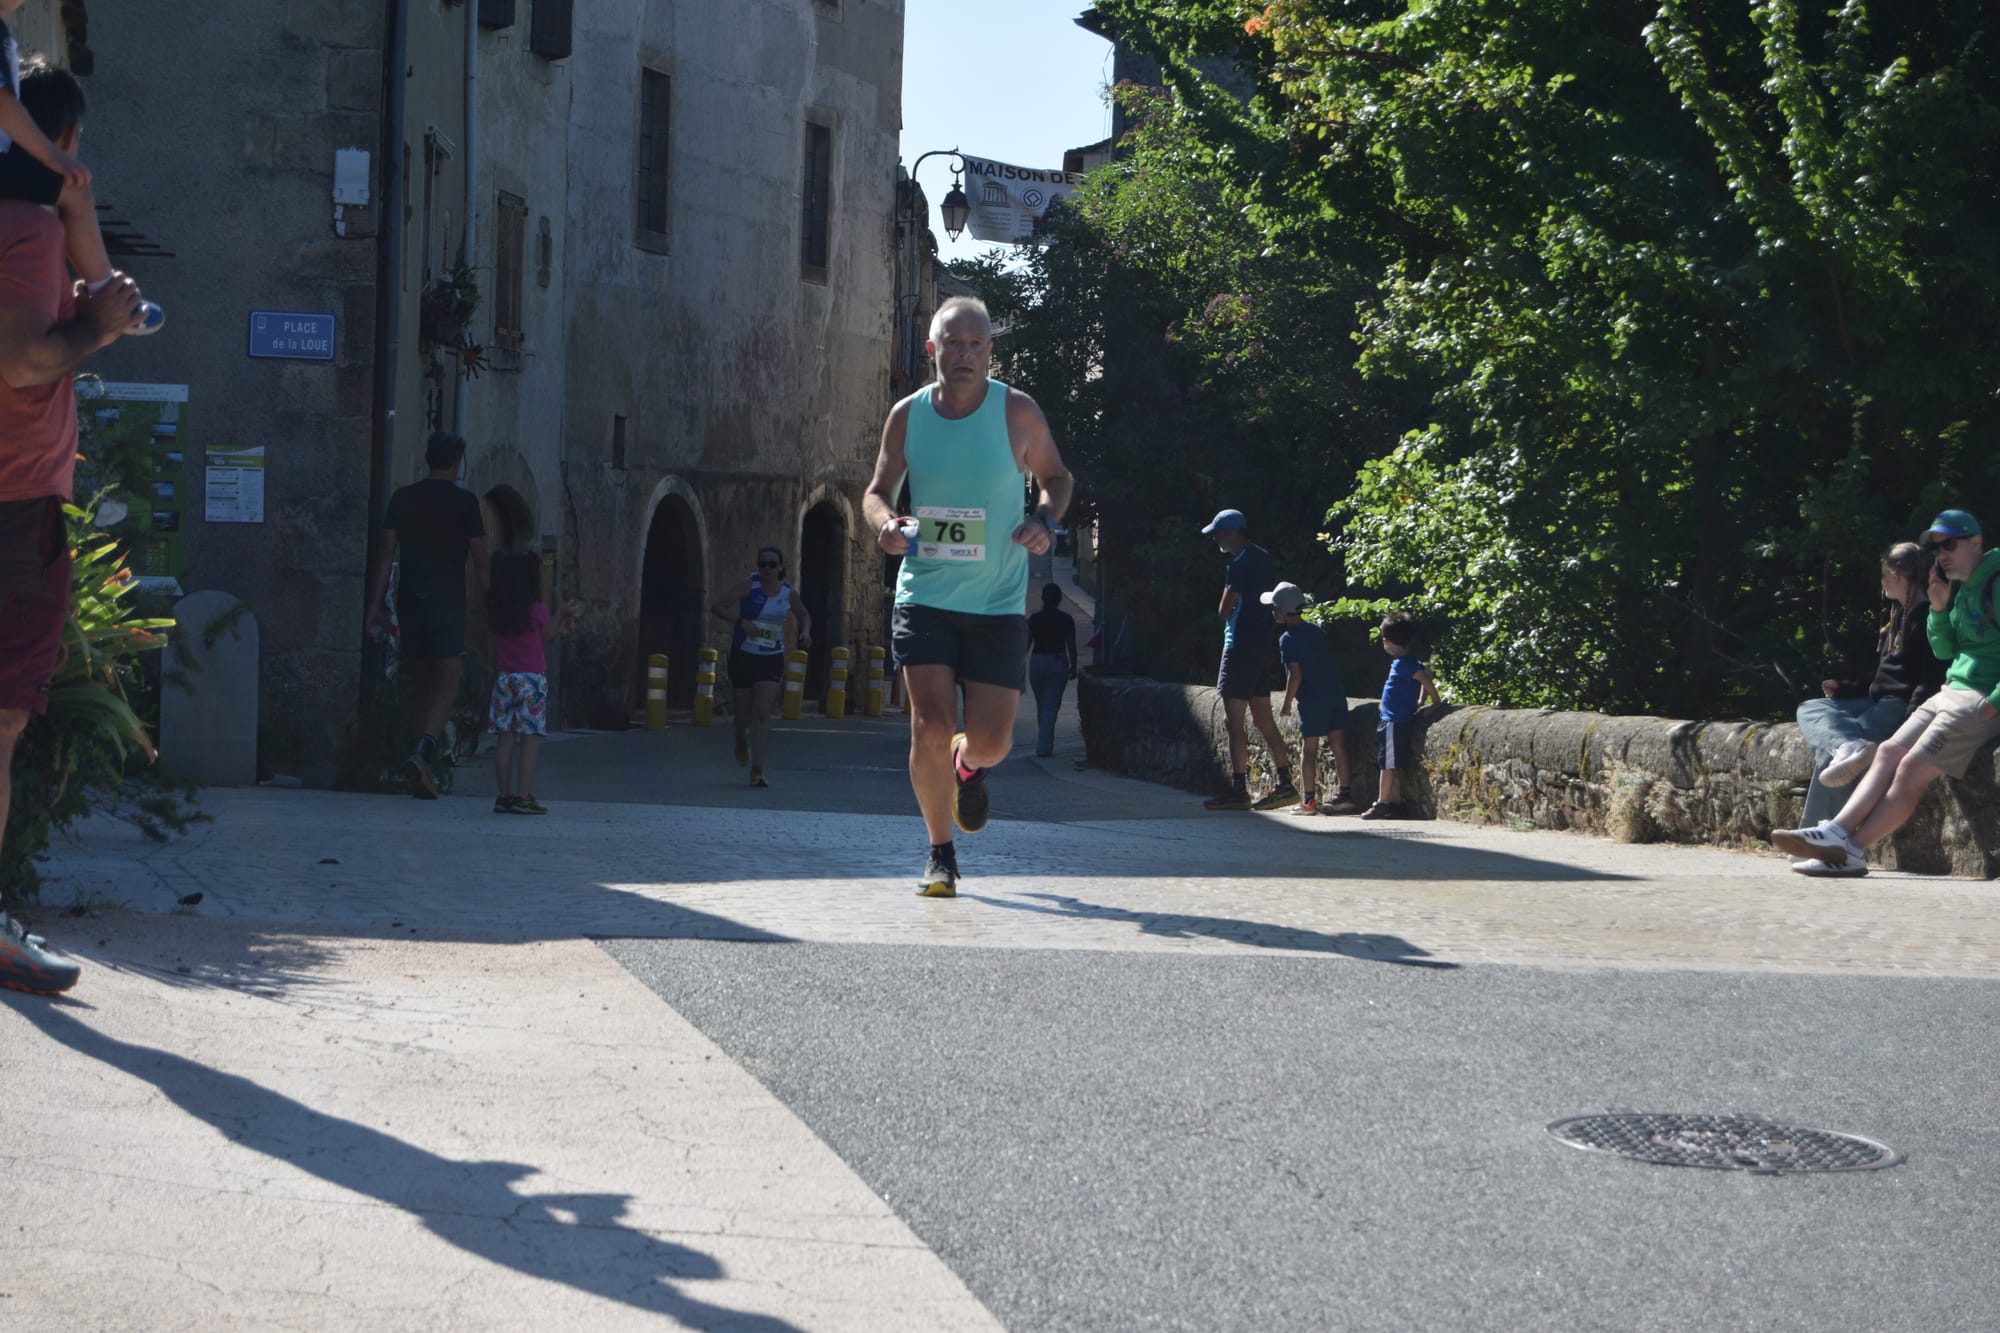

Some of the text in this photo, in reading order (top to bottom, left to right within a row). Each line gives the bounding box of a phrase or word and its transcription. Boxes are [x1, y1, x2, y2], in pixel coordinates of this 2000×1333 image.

[969, 160, 1045, 183] MAISON
[1051, 172, 1075, 184] DE
[284, 321, 317, 334] PLACE
[272, 337, 328, 351] de la LOUE
[934, 521, 966, 543] 76
